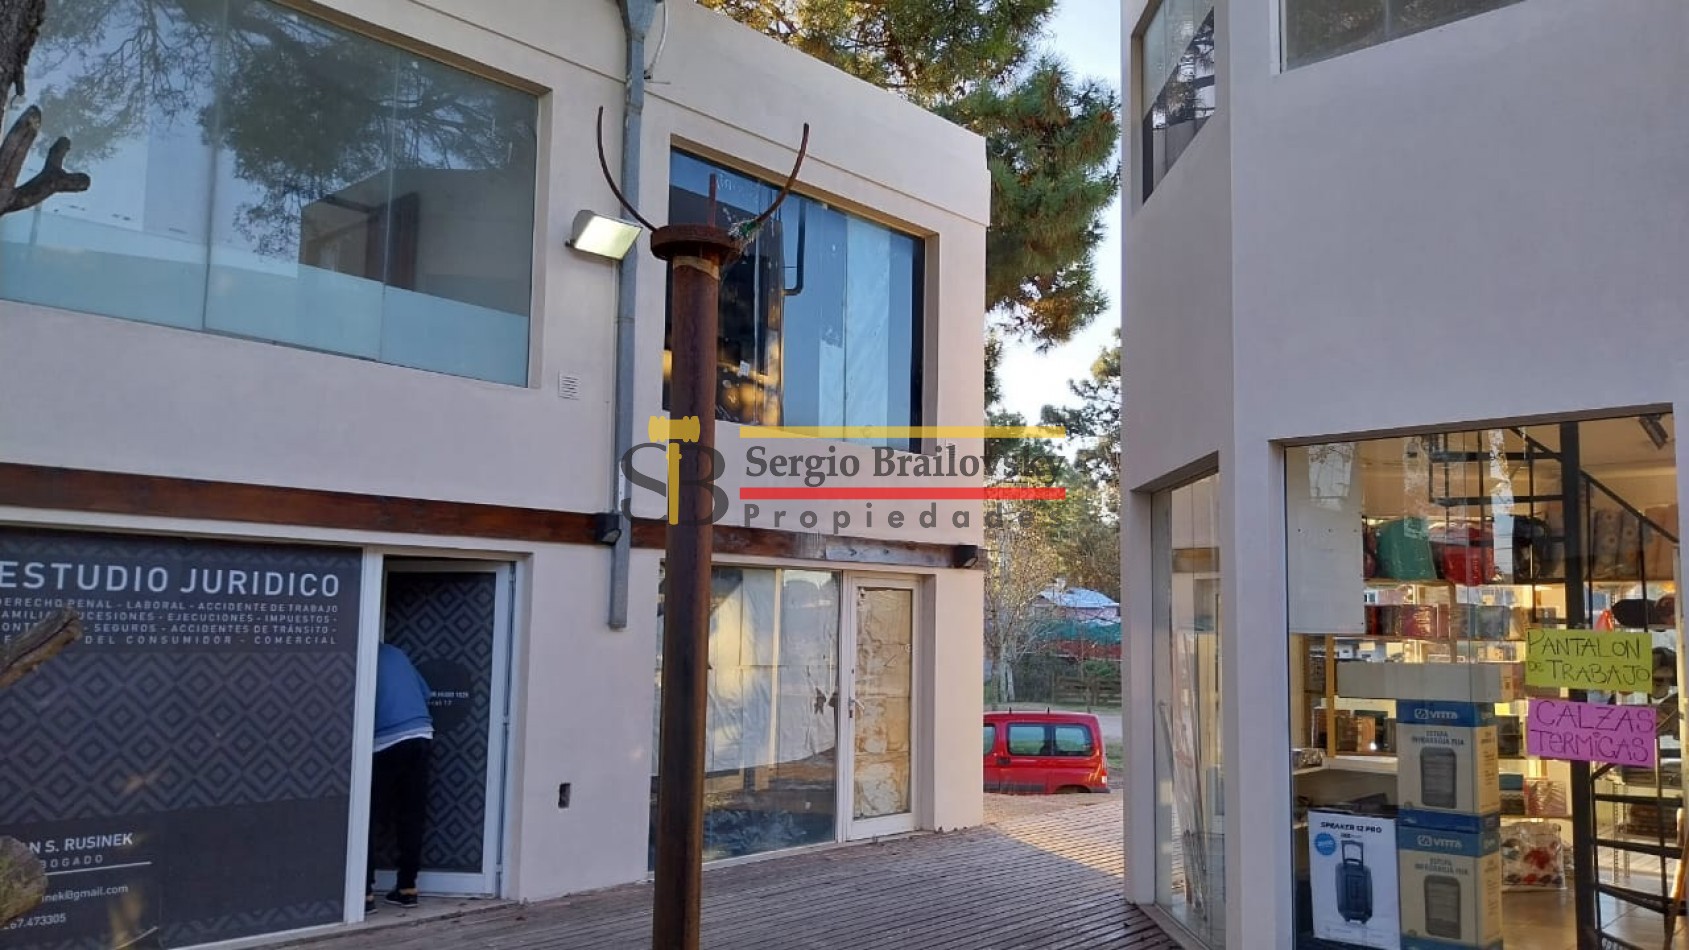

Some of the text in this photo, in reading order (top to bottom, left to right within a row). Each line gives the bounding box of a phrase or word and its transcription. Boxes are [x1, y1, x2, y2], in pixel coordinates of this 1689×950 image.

[0, 561, 339, 597] ESTUDIO JURIDICO
[0, 597, 338, 613] ERECHO PENAL LABORAL ACCIDENTE DE TRABAJO
[1, 610, 330, 623] AMILI UCESIONES EJECUCIONES IMPUESTOS
[94, 623, 156, 633] SEGUROS
[171, 624, 249, 633] ACCIDENTES
[254, 624, 269, 633] DE
[85, 635, 337, 645] DEL CONSUMIDOR COMERCIAL
[1527, 629, 1640, 659] PANTALON
[1545, 659, 1650, 686] TRABAJO
[1536, 700, 1654, 733] CALZAS
[1320, 821, 1355, 831] SPEAKER
[1365, 826, 1383, 834] PRO
[64, 833, 133, 851] RUSINEK
[41, 855, 103, 868] BOGADO
